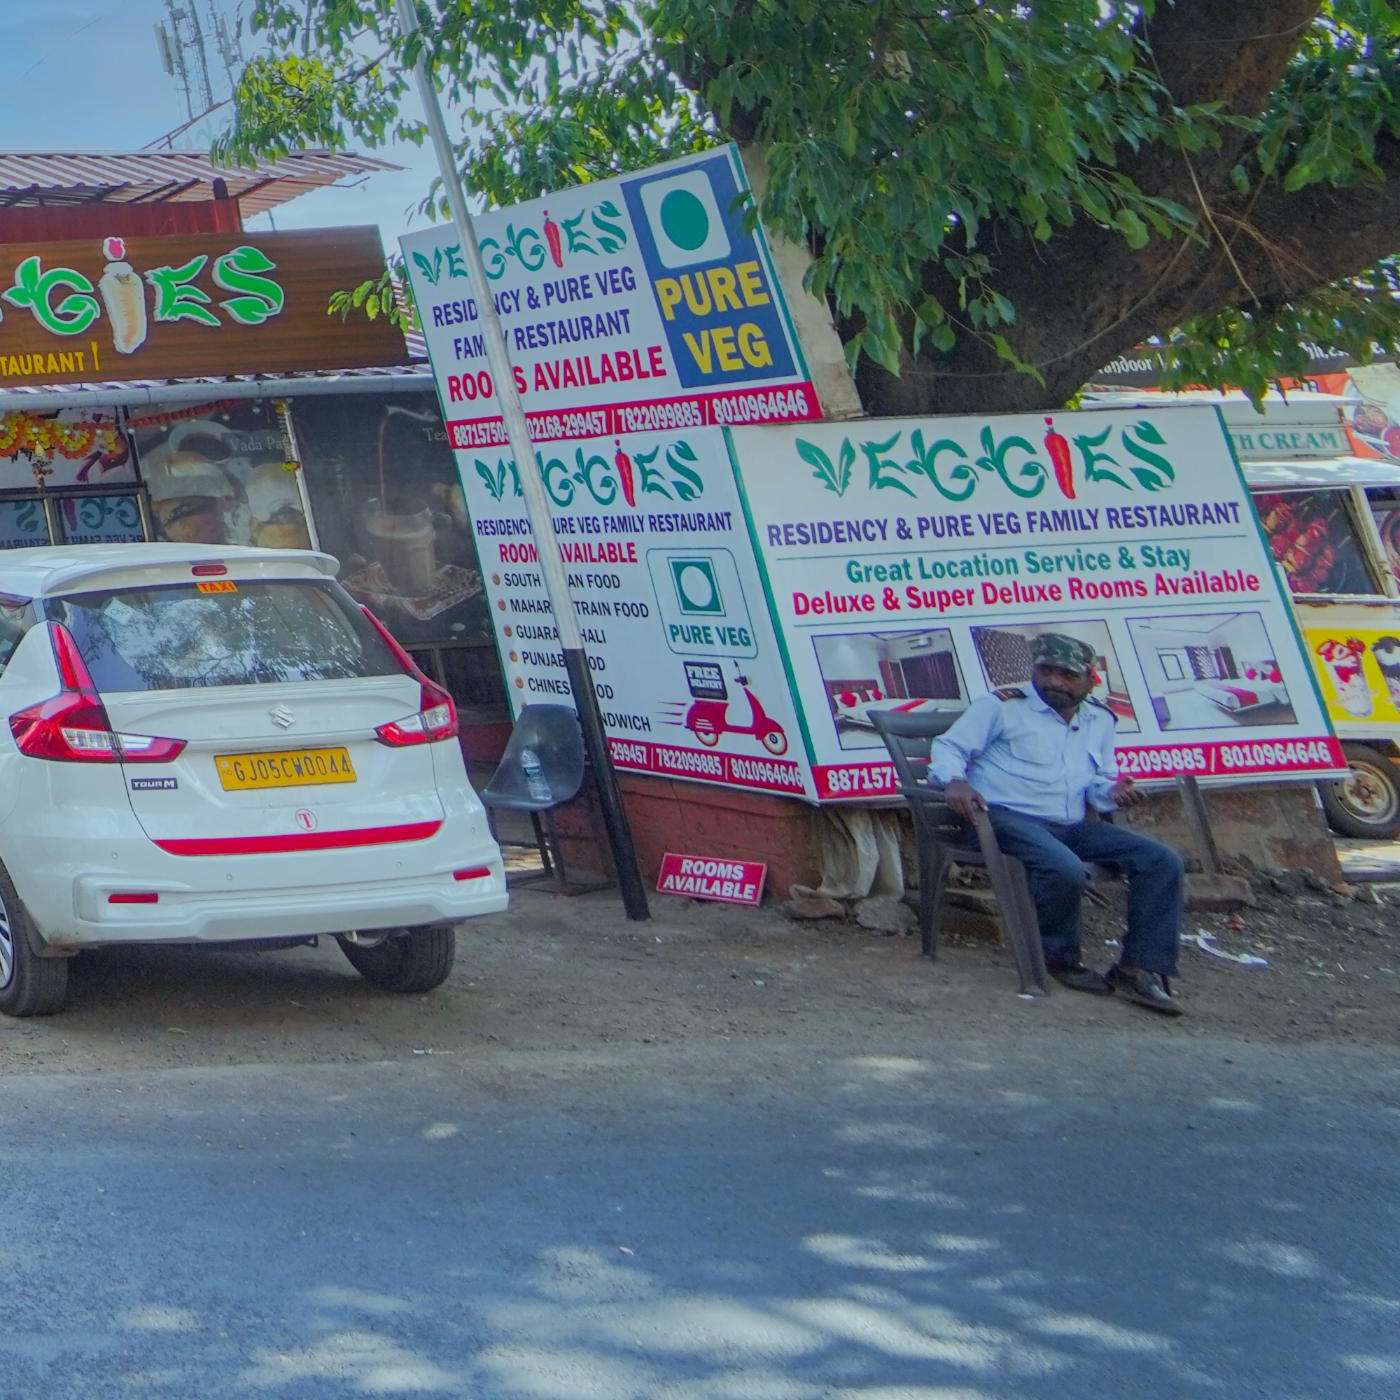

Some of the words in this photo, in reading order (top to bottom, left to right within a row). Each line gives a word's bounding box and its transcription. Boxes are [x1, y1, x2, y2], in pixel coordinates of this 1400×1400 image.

[432, 289, 520, 327] RESIDNCY
[527, 286, 541, 309] &
[543, 275, 593, 306] PURE
[595, 266, 637, 296] VEG
[655, 260, 770, 321] PURE
[514, 308, 631, 350] RESTAURANT
[683, 323, 773, 374] VEG
[448, 366, 527, 402] ROOS
[534, 346, 666, 391] AVAILABLE
[617, 400, 701, 431] 7822099885
[712, 389, 808, 424] 8010964646
[230, 437, 262, 451] Vada
[1259, 432, 1339, 450] CREAM
[795, 416, 1175, 501] VEGGIES
[554, 516, 575, 535] URE
[579, 515, 600, 534] VEG
[603, 514, 645, 534] FAMILY
[649, 511, 732, 533] RESTAURANT
[767, 519, 888, 547] RESIDENCY
[895, 517, 912, 540] &
[917, 514, 972, 540] PURE
[977, 511, 1021, 536] VEG
[1027, 508, 1099, 534] FAMILY
[1106, 502, 1240, 530] RESTAURANT
[499, 542, 541, 563] ROOM
[846, 557, 912, 584] Great
[919, 552, 1019, 580] Location
[1025, 548, 1111, 575] Service
[1117, 547, 1135, 570] &
[1141, 544, 1191, 574] Stay
[199, 581, 235, 593] TAXI
[504, 572, 541, 588] SOUTH
[588, 574, 621, 589] FOOD
[793, 589, 877, 615] Deluxe
[882, 587, 900, 610] &
[905, 583, 974, 613] Super
[983, 579, 1062, 606] Deluxe
[1068, 575, 1148, 599] Rooms
[1154, 568, 1260, 596] Available
[510, 599, 612, 617] MAHARTRAIN
[614, 601, 649, 618] FOOD
[516, 624, 559, 641] GUJARA
[669, 624, 714, 645] PURE
[716, 625, 751, 647] VEG
[522, 651, 566, 668] PUNJAB
[686, 665, 721, 680] FREE
[528, 677, 571, 695] CHINES
[602, 712, 652, 732] NDWICH
[656, 747, 722, 776] 7822099885
[1221, 741, 1331, 768] 8010964646
[233, 754, 350, 782] GJ05CW0044
[299, 813, 312, 829] T
[681, 859, 744, 880] ROOMS
[663, 874, 756, 900] AVAILABLE
